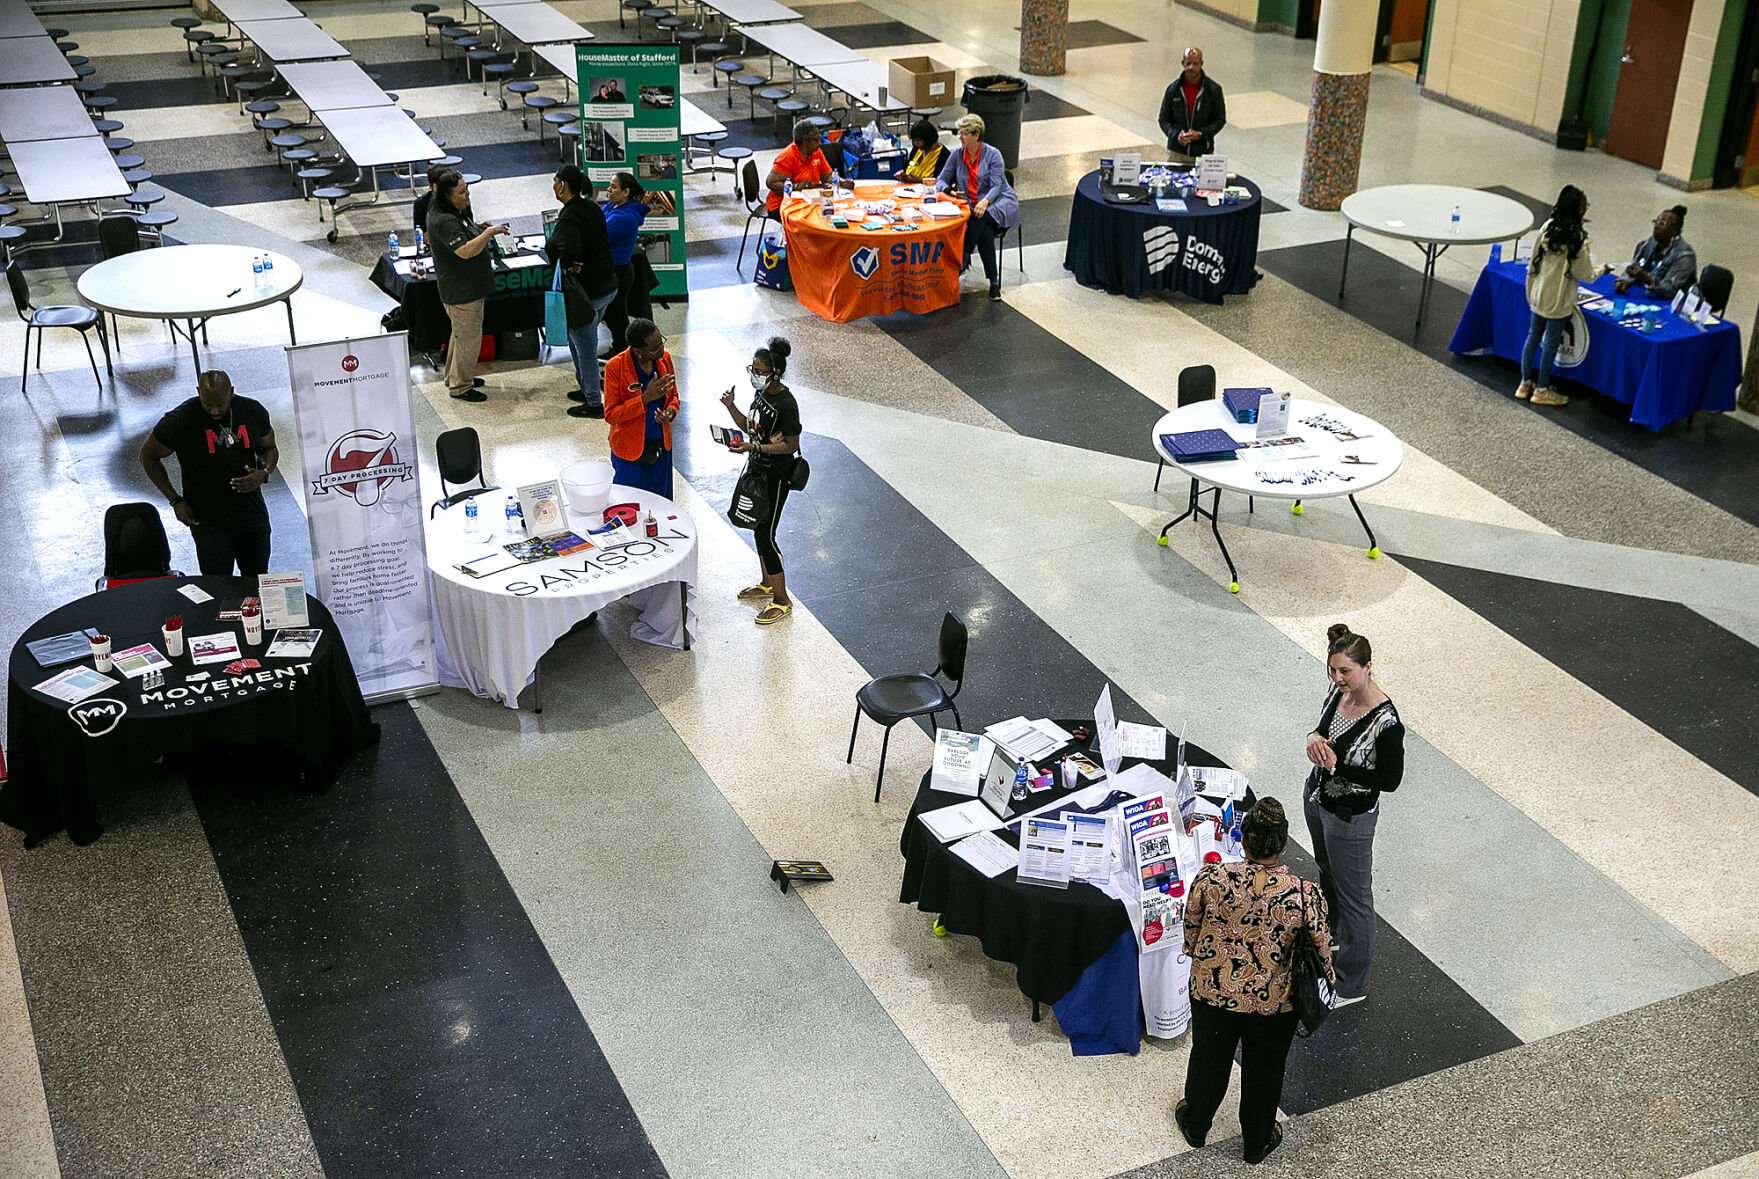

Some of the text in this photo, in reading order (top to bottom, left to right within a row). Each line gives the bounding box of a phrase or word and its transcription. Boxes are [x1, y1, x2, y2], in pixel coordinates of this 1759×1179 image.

[578, 53, 676, 62] HouseMaster of Stafford
[332, 475, 347, 483] DAY
[351, 467, 403, 479] PROCESSING
[371, 548, 396, 556] working
[353, 558, 386, 568] processing
[505, 528, 690, 597] SAMSON
[355, 566, 376, 575] reduce
[551, 548, 675, 593] PROPERTIES
[345, 584, 369, 593] process
[375, 574, 414, 587] goal-oriented
[367, 581, 418, 596] deadline-oriented
[353, 598, 374, 606] unique
[382, 590, 412, 601] Movement
[140, 662, 312, 705] MOVEMENT
[164, 680, 297, 710] MORTGAGE
[947, 748, 969, 756] EXPLORE
[943, 756, 963, 764] FUTURE
[1125, 805, 1144, 815] WIOA
[1131, 820, 1148, 831] WIOA
[1142, 898, 1150, 906] DO
[1142, 897, 1172, 910] NEED HELP?
[1169, 1004, 1184, 1016] proud
